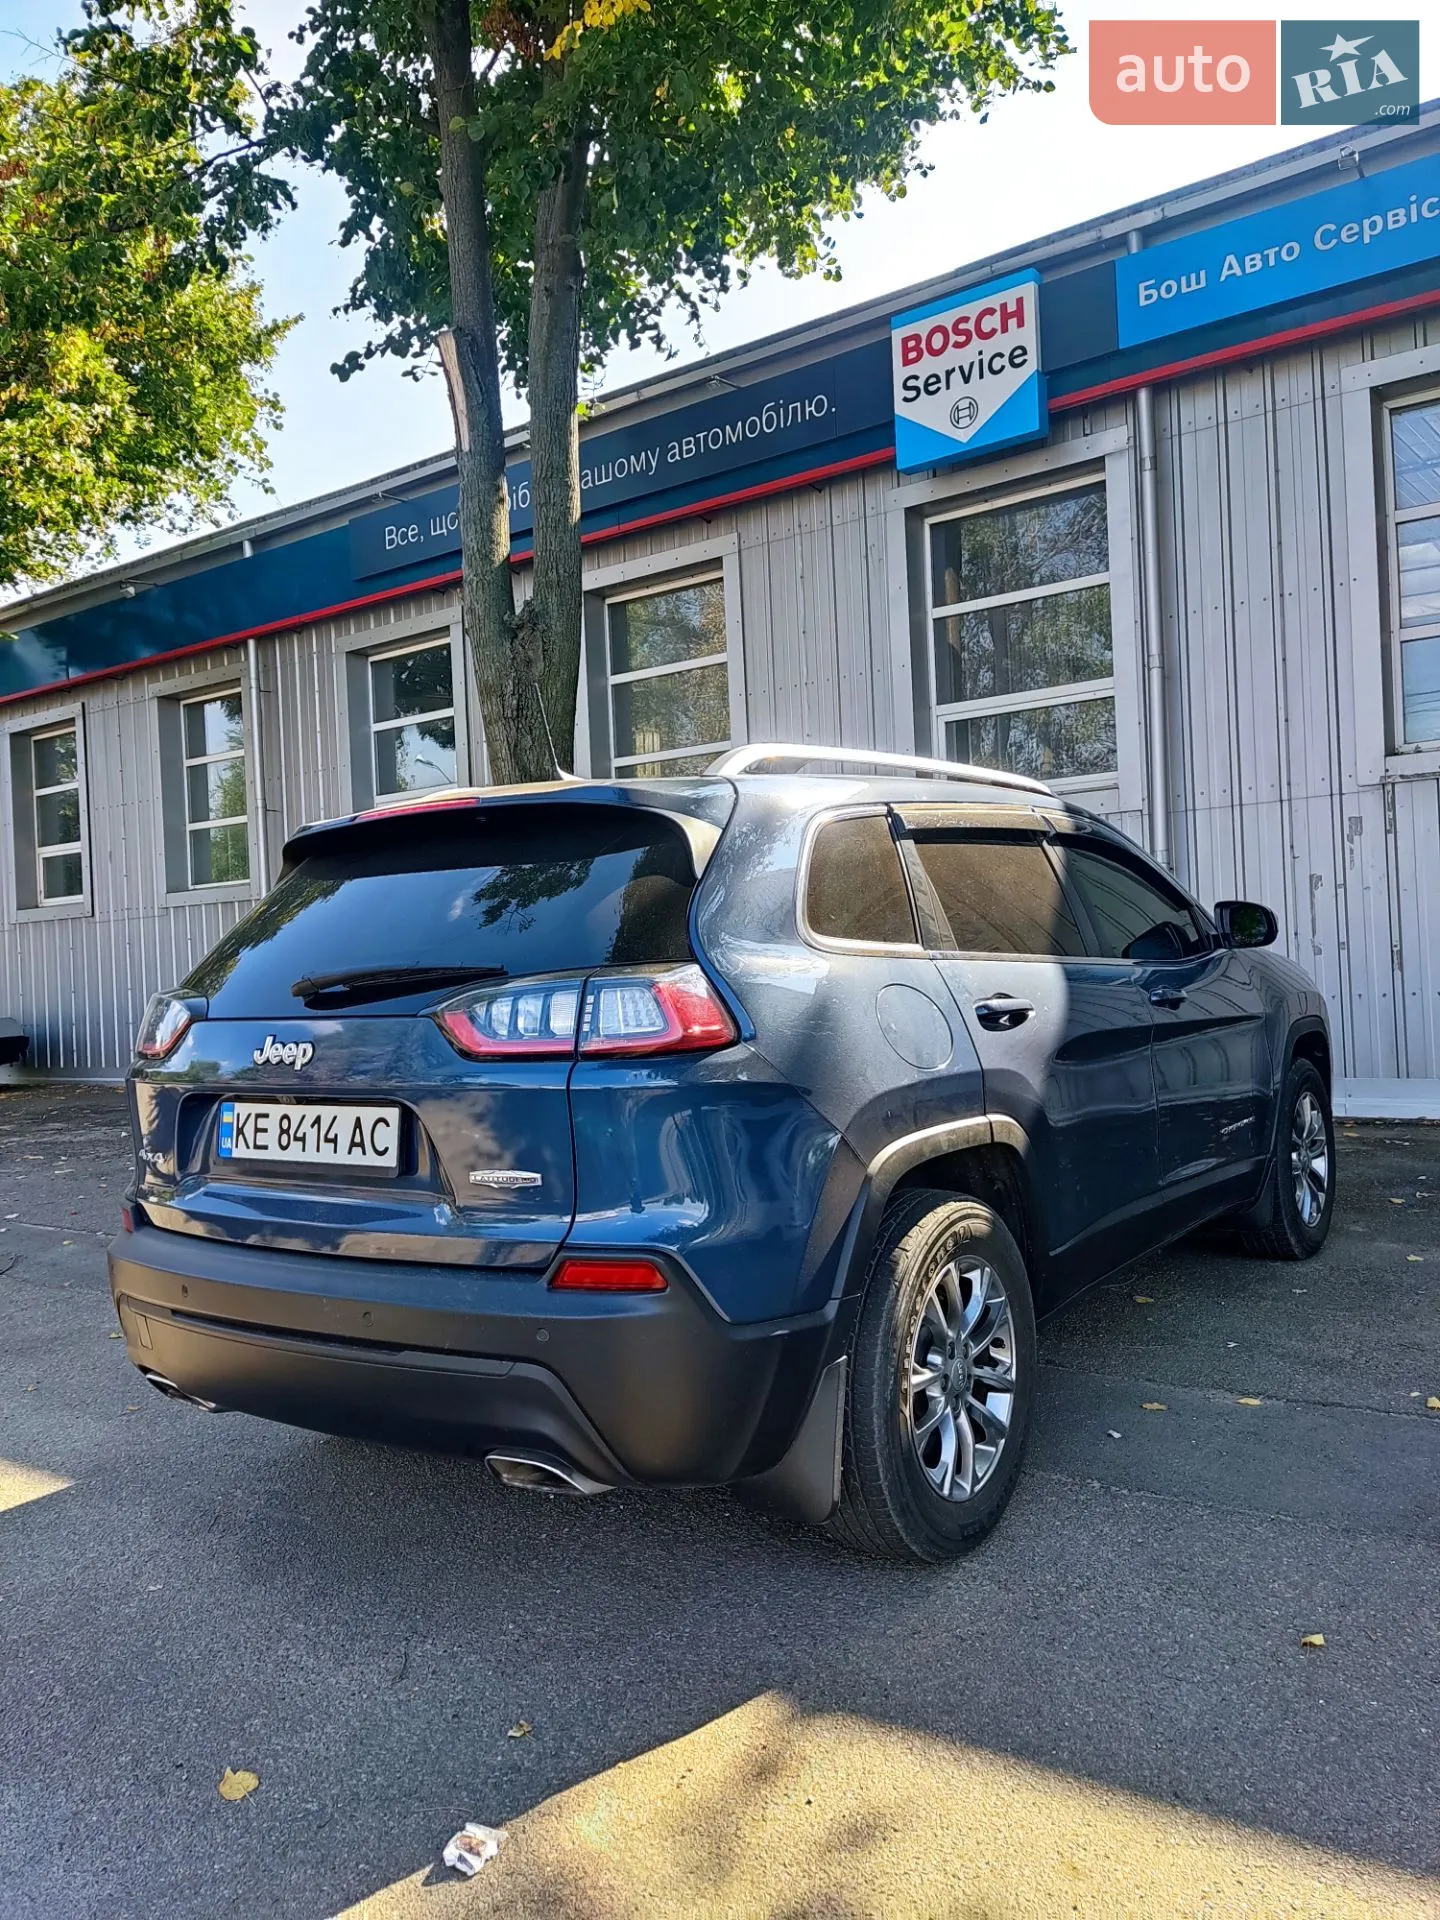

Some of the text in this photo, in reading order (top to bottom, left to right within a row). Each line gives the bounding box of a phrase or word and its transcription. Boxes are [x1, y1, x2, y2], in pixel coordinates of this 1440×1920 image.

[1138, 194, 1440, 307] Бош Авто Сервіс
[901, 296, 1025, 367] BOSCH
[902, 345, 1028, 403] Service
[385, 524, 424, 550] Все,
[430, 511, 459, 537] що
[581, 446, 660, 490] ашому
[667, 394, 836, 463] автомобілю.
[253, 1034, 314, 1071] Jeep
[221, 1136, 232, 1149] UA
[235, 1112, 391, 1157] KE 8414 AC
